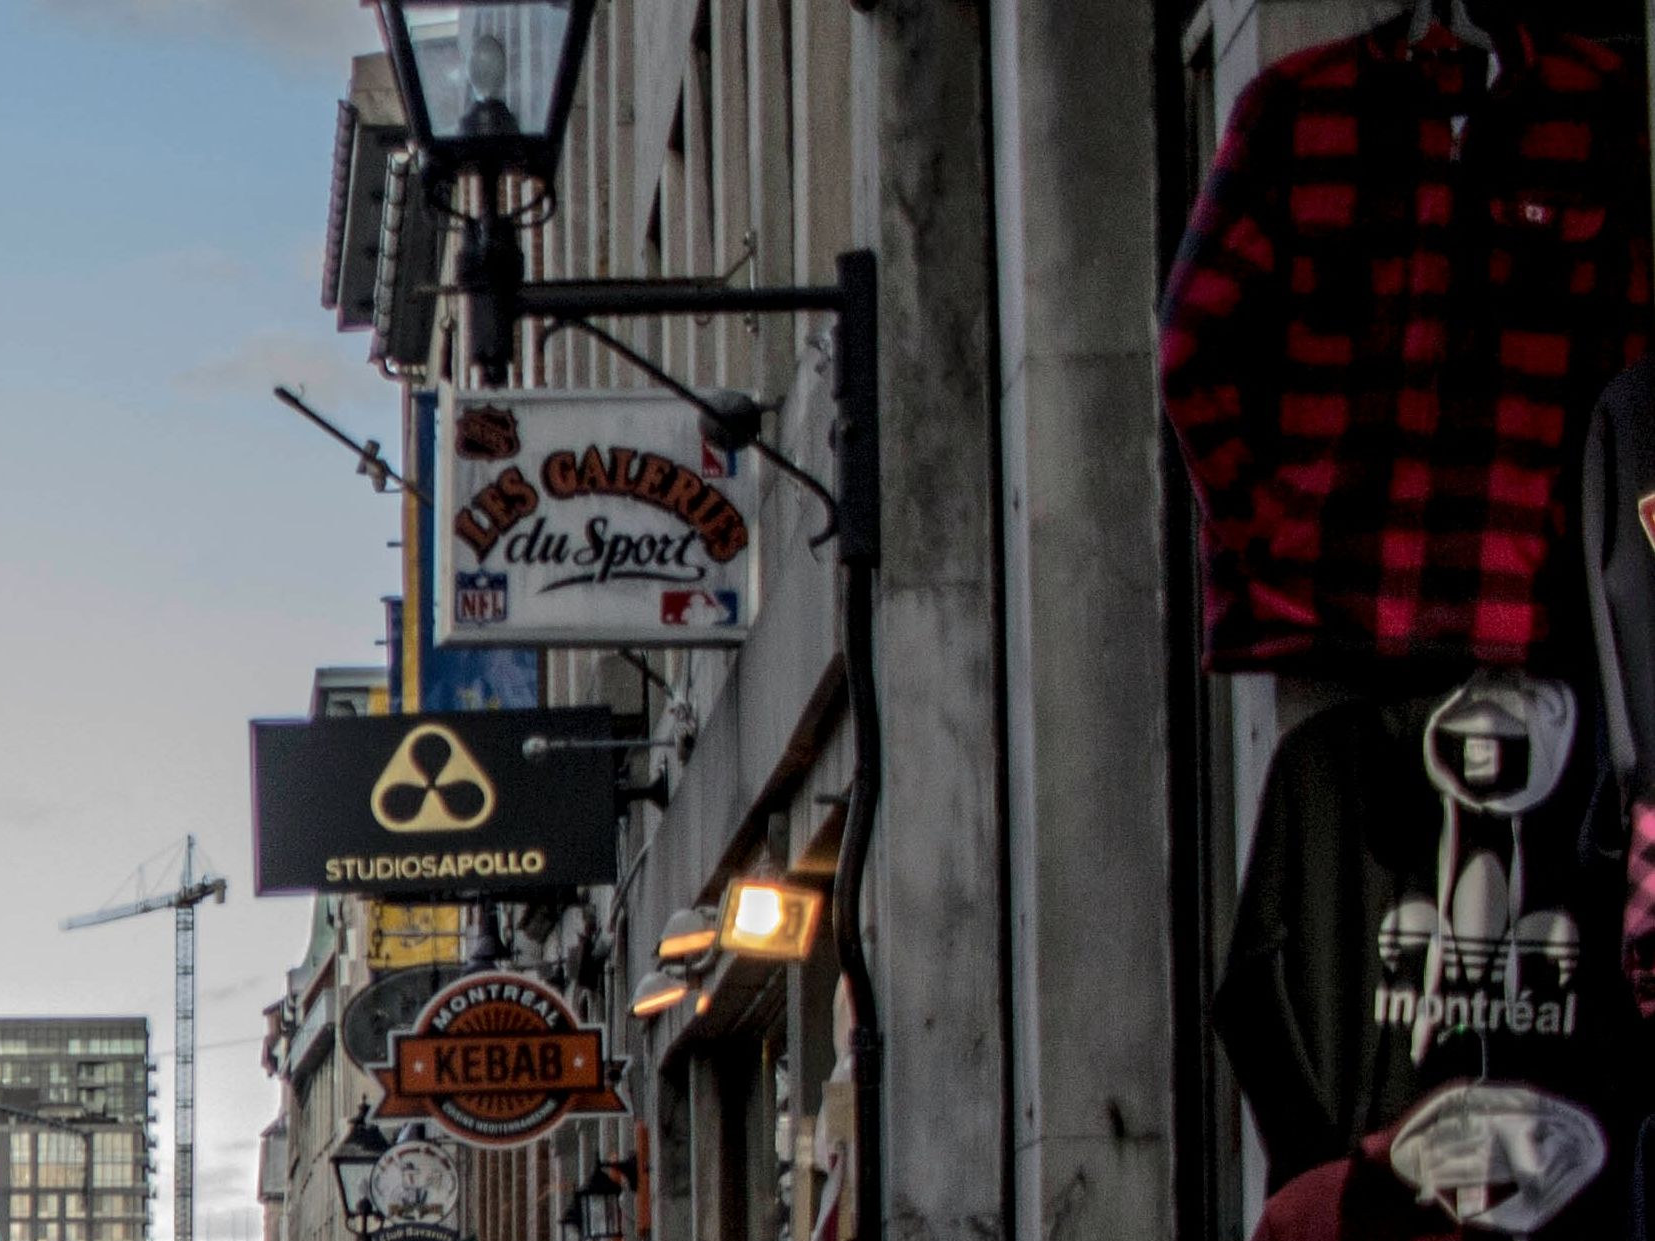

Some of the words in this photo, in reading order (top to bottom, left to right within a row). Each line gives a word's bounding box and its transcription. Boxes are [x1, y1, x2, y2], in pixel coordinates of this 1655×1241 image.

[455, 466, 538, 563] LES
[542, 444, 748, 562] GALERIES
[506, 517, 568, 564] du
[573, 515, 705, 583] Sport
[460, 591, 503, 619] NFL
[1372, 985, 1579, 1037] montréal
[433, 1042, 563, 1085] KEBAB
